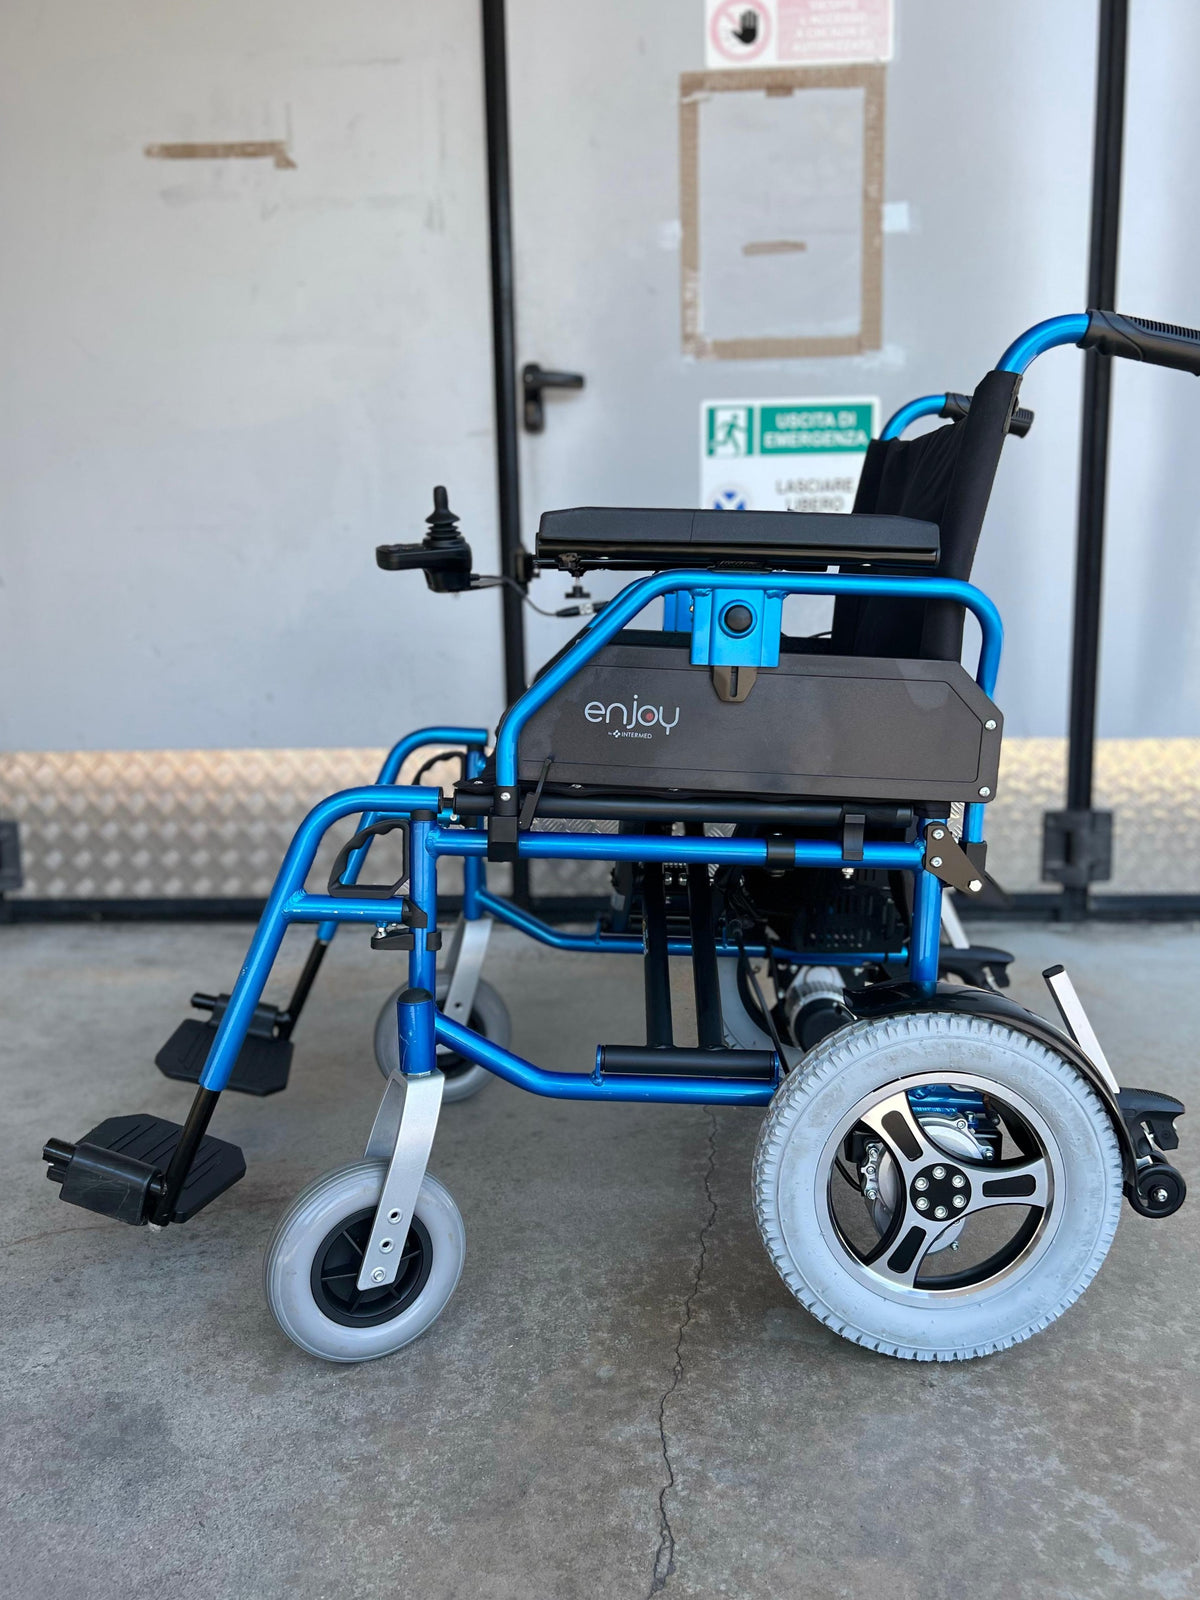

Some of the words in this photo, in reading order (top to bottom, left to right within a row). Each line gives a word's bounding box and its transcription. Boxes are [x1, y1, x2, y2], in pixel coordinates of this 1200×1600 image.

[775, 411, 836, 429] USCITA
[837, 411, 857, 428] DI
[762, 429, 869, 449] EMERGENZA
[775, 477, 855, 495] LASCIARE
[785, 496, 845, 512] LIBERO
[584, 694, 680, 735] enjoy
[621, 731, 653, 739] INTERMED
